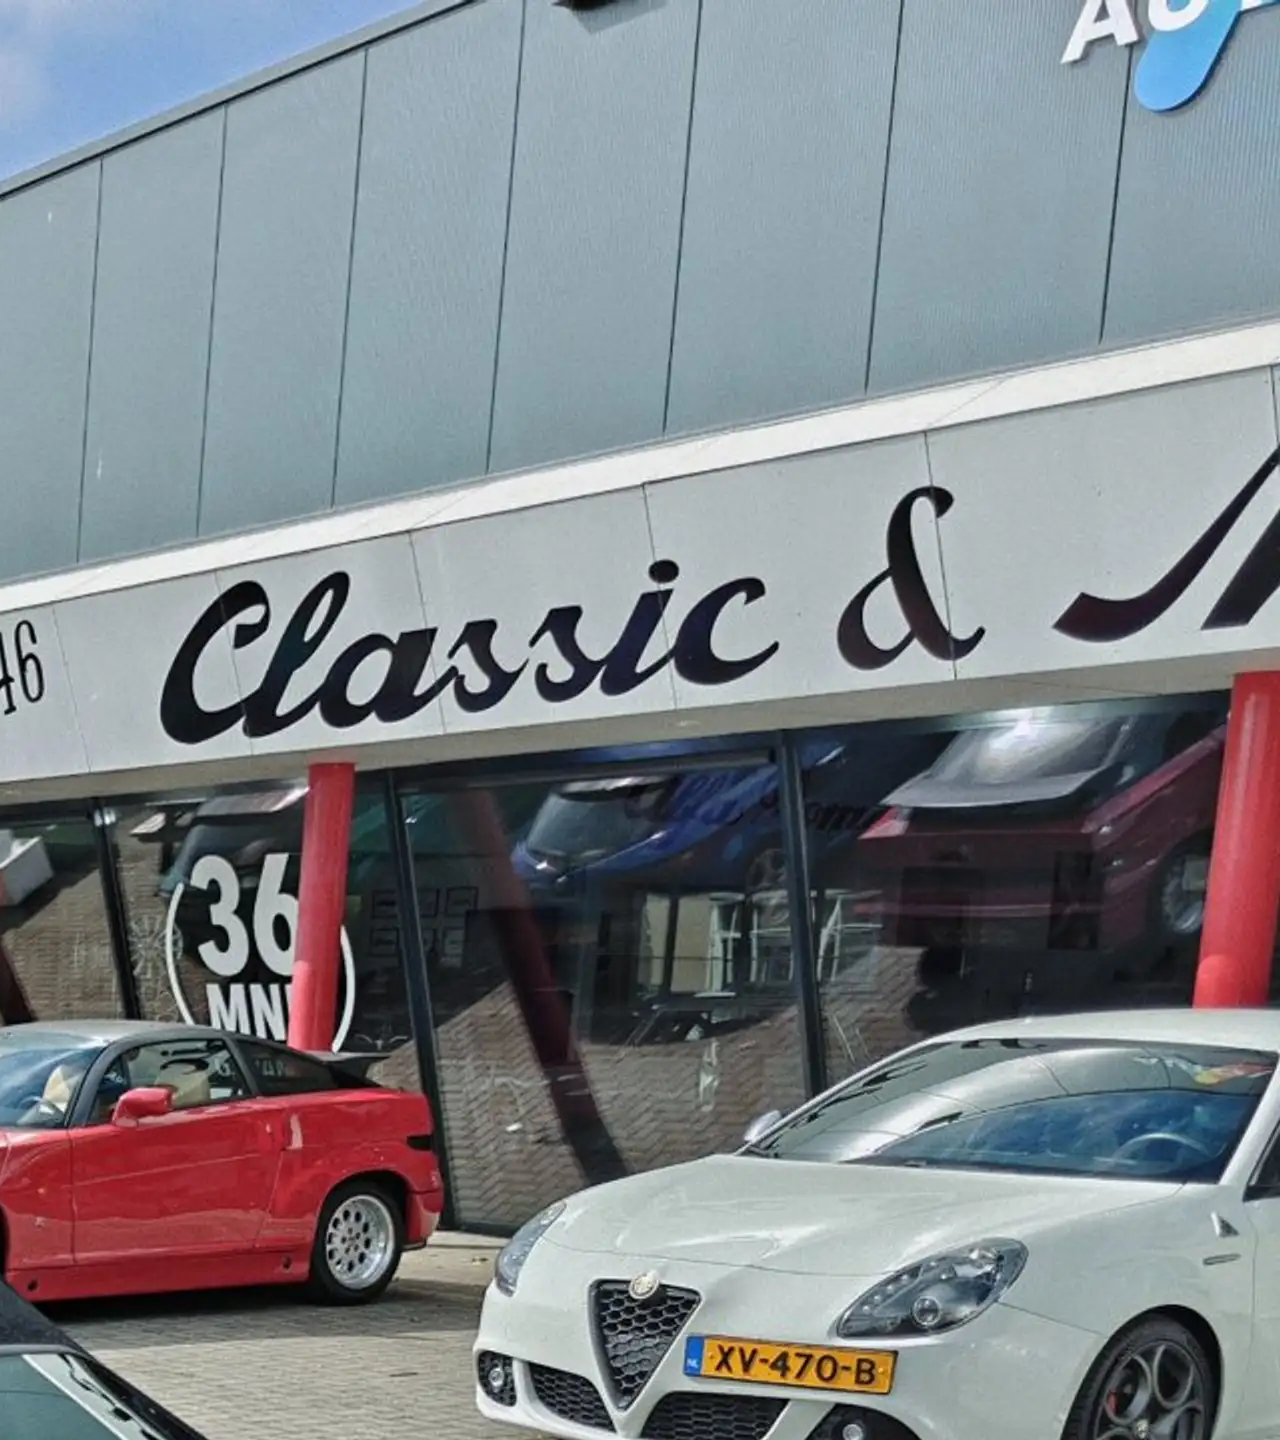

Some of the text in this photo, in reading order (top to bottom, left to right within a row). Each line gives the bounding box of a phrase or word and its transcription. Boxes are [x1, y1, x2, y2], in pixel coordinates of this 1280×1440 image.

[159, 560, 780, 746] Classic
[837, 486, 985, 670] &
[191, 852, 299, 977] 36
[206, 983, 294, 1042] MN
[714, 1344, 876, 1386] XV-470-B
